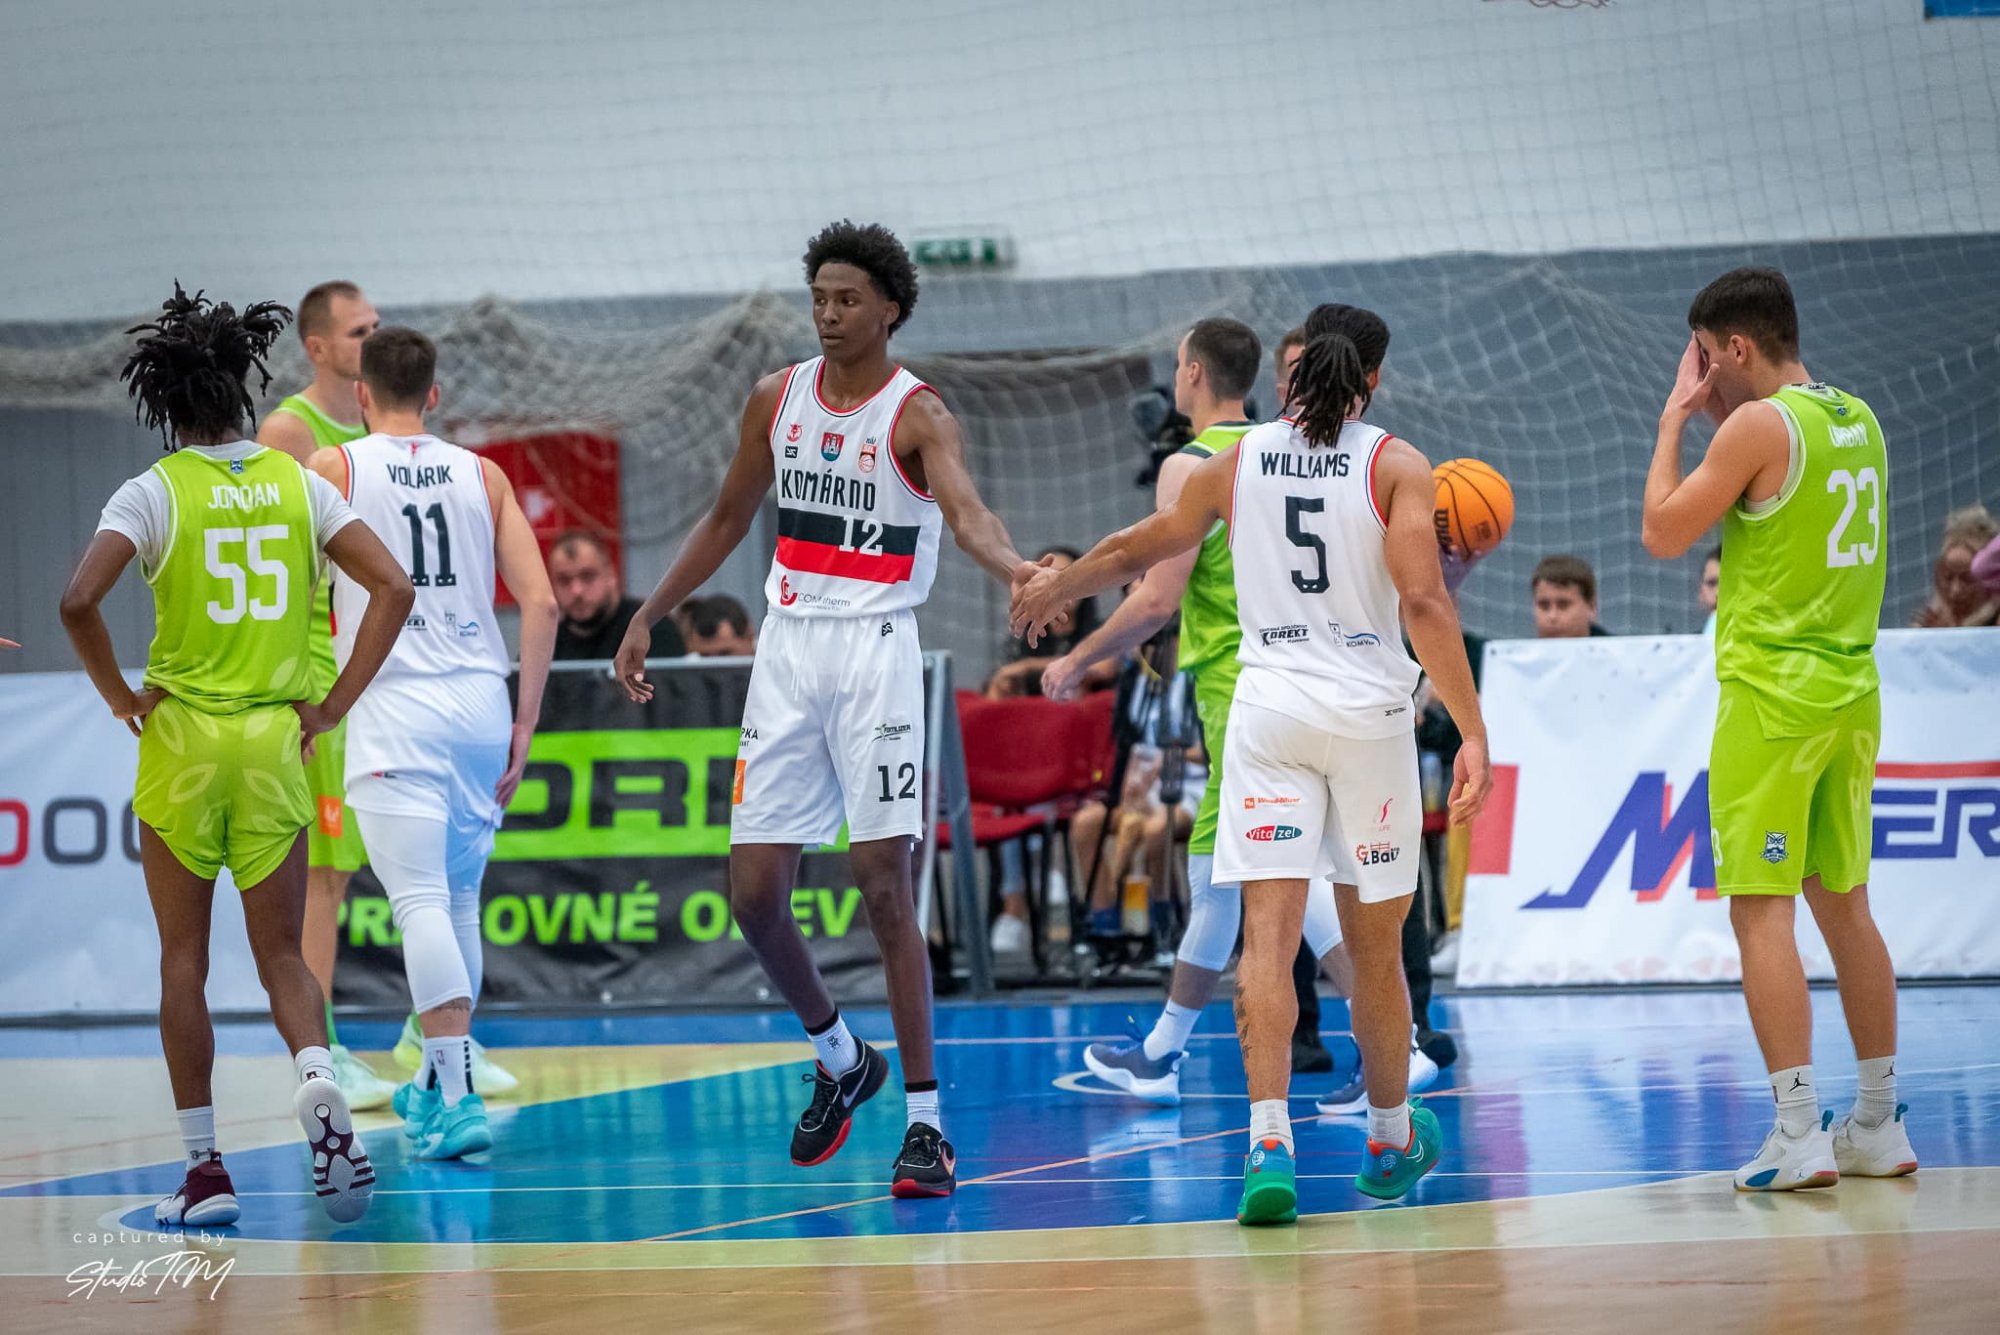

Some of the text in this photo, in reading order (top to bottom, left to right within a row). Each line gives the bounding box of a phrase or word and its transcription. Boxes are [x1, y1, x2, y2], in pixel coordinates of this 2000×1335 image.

[386, 463, 453, 489] VOLÁRIK
[1260, 451, 1351, 479] WILLIAMS
[207, 482, 281, 514] JORDAN
[781, 467, 876, 512] KOMÁRNO
[838, 514, 883, 557] 12
[1826, 466, 1880, 569] 23
[402, 502, 457, 587] 11
[1285, 495, 1330, 594] 5
[204, 524, 289, 624] 55
[878, 762, 917, 803] 12
